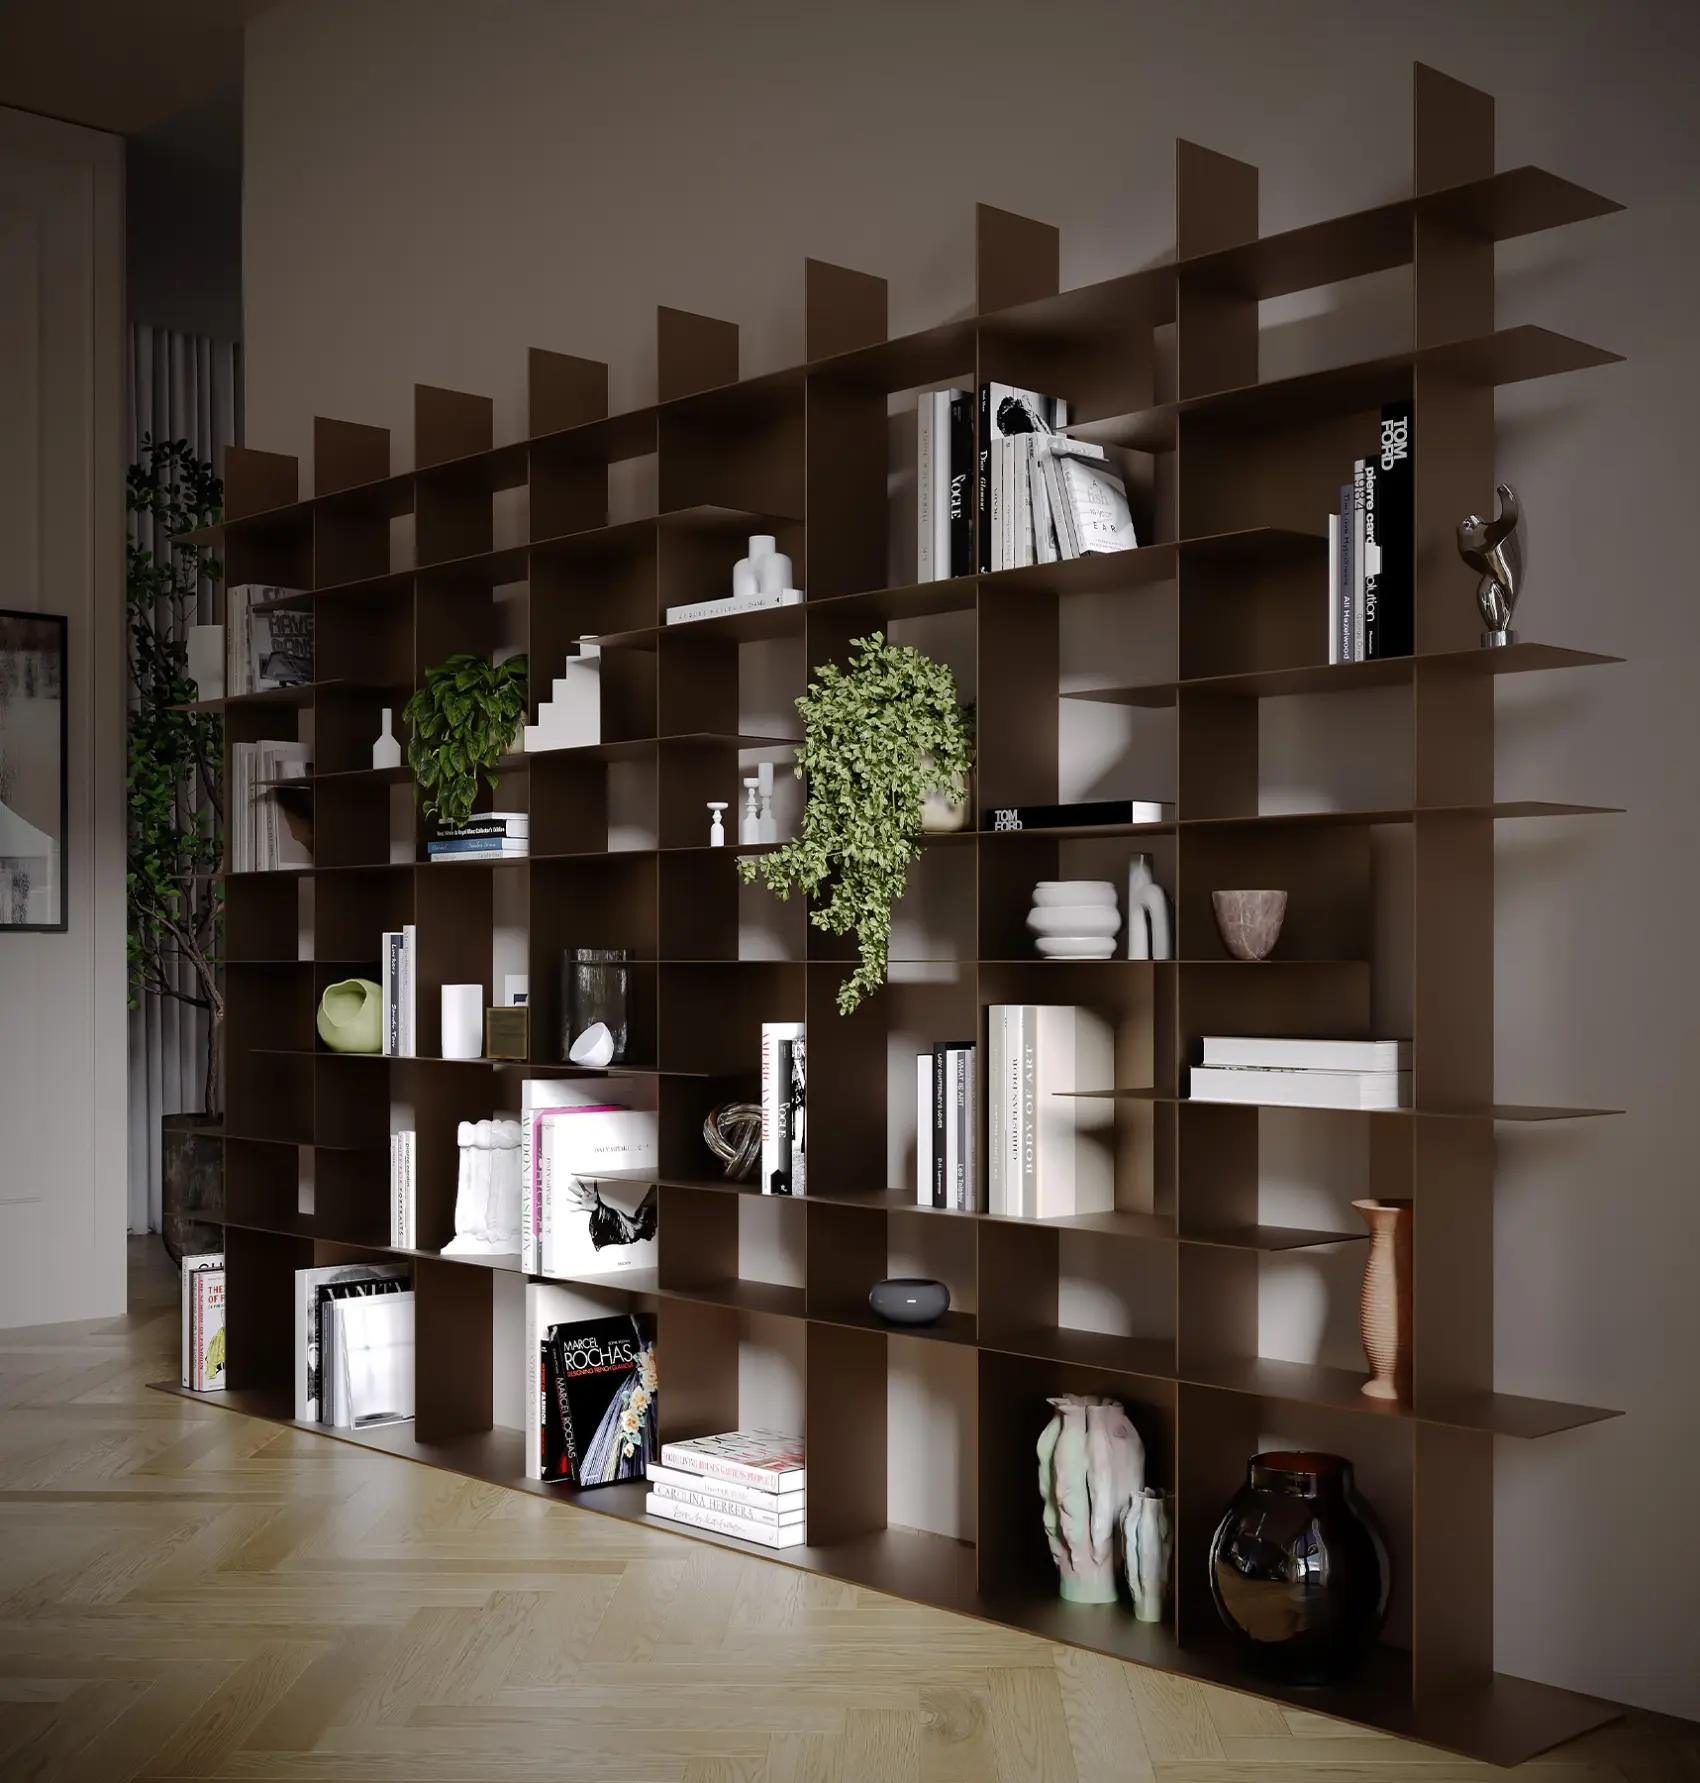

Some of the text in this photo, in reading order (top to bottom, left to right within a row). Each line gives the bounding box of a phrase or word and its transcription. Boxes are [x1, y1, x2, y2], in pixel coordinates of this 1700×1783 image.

[1380, 419, 1395, 471] FORD
[1393, 415, 1408, 460] TOM
[979, 449, 988, 472] Dior
[951, 473, 967, 520] VOGUE
[1087, 486, 1109, 506] fish
[1353, 468, 1367, 511] 1984
[1365, 466, 1377, 511] pierre
[1092, 521, 1118, 534] EAR
[1343, 596, 1351, 660] Ali Hazelwood
[995, 809, 1018, 821] TOM
[995, 820, 1023, 831] FORD
[762, 1033, 770, 1142] AMERICAN DIOR
[958, 1082, 965, 1091] IS
[778, 1102, 791, 1138] VOGUE
[1025, 1044, 1033, 1174] BODY OF ART
[522, 1116, 532, 1252] AVEDON FASHION
[957, 1179, 965, 1203] Tolstoy
[208, 1285, 223, 1295] THE
[208, 1294, 219, 1304] OF
[563, 1336, 599, 1352] MARCEL
[563, 1343, 633, 1371] ROCHAS
[566, 1367, 594, 1378] DESIGNING
[593, 1365, 612, 1374] FRENCH
[556, 1377, 568, 1416] MARCEL
[561, 1416, 576, 1459] ROCHAS
[657, 1484, 705, 1507] CAROLINA
[708, 1494, 754, 1520] HERRERA
